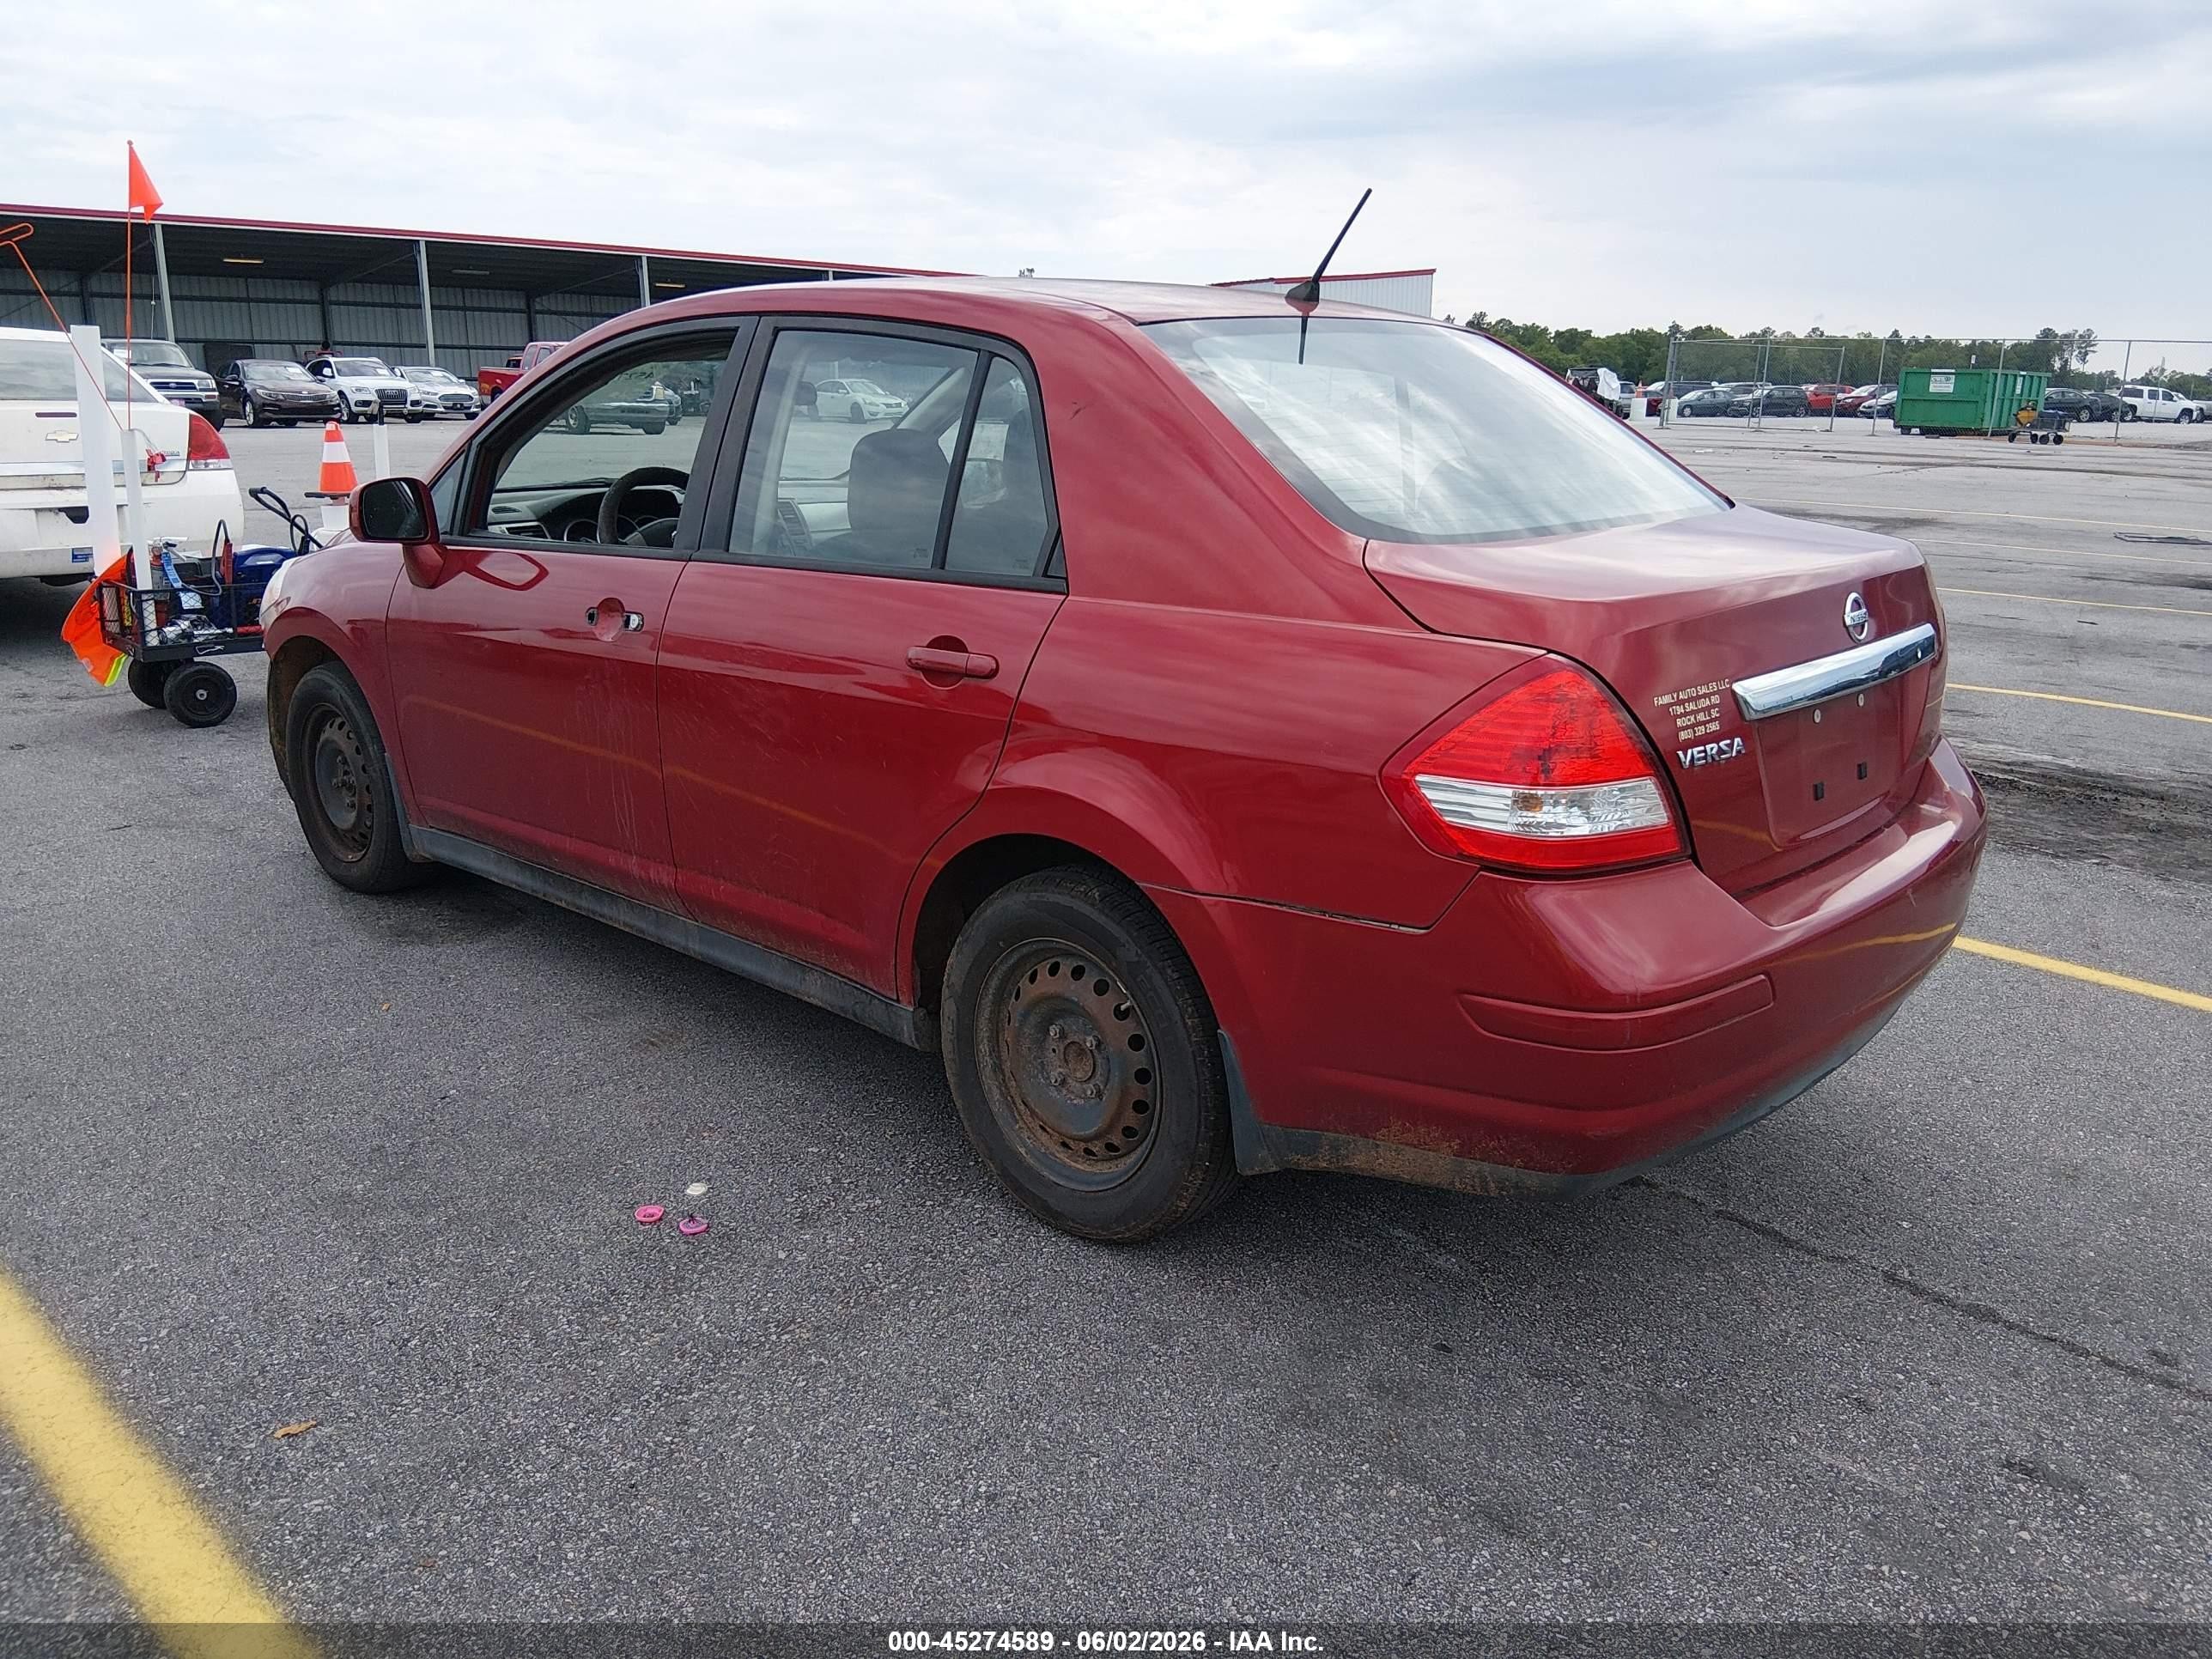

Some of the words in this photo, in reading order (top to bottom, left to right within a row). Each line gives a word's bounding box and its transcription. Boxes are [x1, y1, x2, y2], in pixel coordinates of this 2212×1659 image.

[1654, 691, 1678, 707] FAMILY
[1679, 688, 1697, 700] AUTO
[1698, 682, 1717, 695] SALES
[1717, 678, 1730, 690] LLC
[1669, 705, 1685, 716] 1794
[1686, 698, 1711, 712] SALUDA
[1711, 695, 1720, 705] RD
[1676, 715, 1696, 728] ROCK
[1696, 711, 1711, 722] HILL
[1711, 708, 1720, 718] SC
[1678, 727, 1694, 743] (803)
[1695, 725, 1705, 736] 329
[1676, 737, 1746, 769] VERSA
